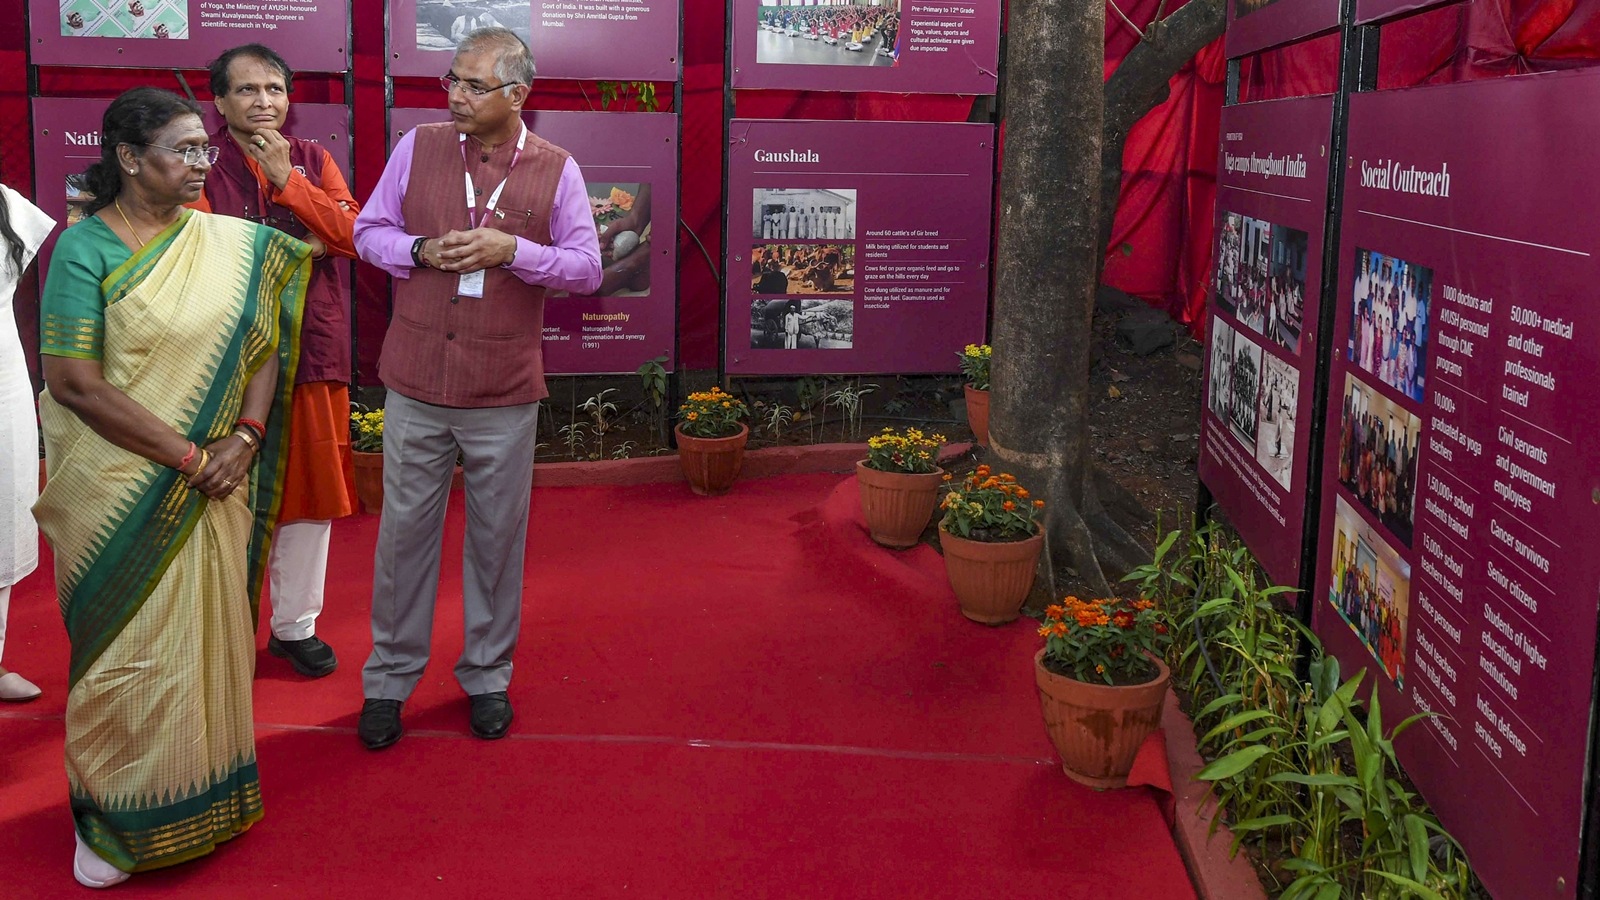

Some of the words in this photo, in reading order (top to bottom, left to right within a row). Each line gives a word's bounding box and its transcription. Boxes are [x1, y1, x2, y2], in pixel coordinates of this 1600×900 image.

[65, 131, 102, 145] Nati
[754, 149, 820, 163] Gaushala
[1250, 152, 1285, 179] throughout
[1286, 154, 1306, 178] India
[1361, 159, 1391, 190] Social
[1393, 162, 1450, 197] Outreach
[582, 312, 630, 322] Naturopathy
[1443, 285, 1456, 301] 1000
[1457, 289, 1479, 309] doctors
[1480, 298, 1493, 313] and
[1440, 308, 1459, 326] AYUSH
[1459, 314, 1489, 338] personnel
[1511, 305, 1541, 328] 50,000+
[1543, 318, 1573, 339] medical
[1439, 330, 1459, 353] through
[1460, 339, 1474, 358] CME
[1508, 334, 1522, 350] and
[1523, 339, 1544, 357] other
[1436, 356, 1462, 377] programs
[1505, 360, 1555, 391] professionals
[1434, 391, 1455, 413] 10,000+
[1503, 384, 1529, 407] trained
[1430, 437, 1453, 462] teachers
[1432, 417, 1458, 443] graduated
[1459, 432, 1466, 446] as
[1467, 436, 1482, 456] yoga
[1498, 426, 1514, 447] Civil
[1514, 436, 1548, 464] servants
[1496, 454, 1510, 471] and
[1510, 463, 1556, 498] government
[1428, 474, 1453, 502] 1,50,000+
[1454, 495, 1474, 518] school
[1494, 479, 1532, 512] employees
[1425, 498, 1447, 524] students
[1448, 514, 1468, 540] trained
[1423, 533, 1443, 559] 15,000+
[1444, 554, 1463, 578] school
[1491, 519, 1514, 548] Cancer
[1515, 539, 1549, 573] survivors
[1421, 556, 1443, 585] teachers
[1443, 575, 1463, 604] trained
[1488, 561, 1509, 590] Senior
[1510, 580, 1537, 613] citizens
[1419, 591, 1434, 618] Police
[1434, 610, 1461, 644] personnel
[1484, 603, 1514, 641] Students
[1514, 633, 1523, 648] of
[1523, 636, 1547, 670] higher
[1416, 629, 1434, 655] School
[1434, 648, 1457, 682] teachers
[1482, 631, 1521, 676] educational
[1415, 649, 1427, 673] from
[1427, 664, 1440, 687] tribal
[1441, 683, 1456, 707] areas
[1480, 651, 1517, 700] institutions
[1413, 686, 1431, 716] Special
[1431, 714, 1457, 751] educators
[1477, 694, 1497, 726] Indian
[1498, 717, 1526, 756] defense
[1475, 722, 1502, 758] services
